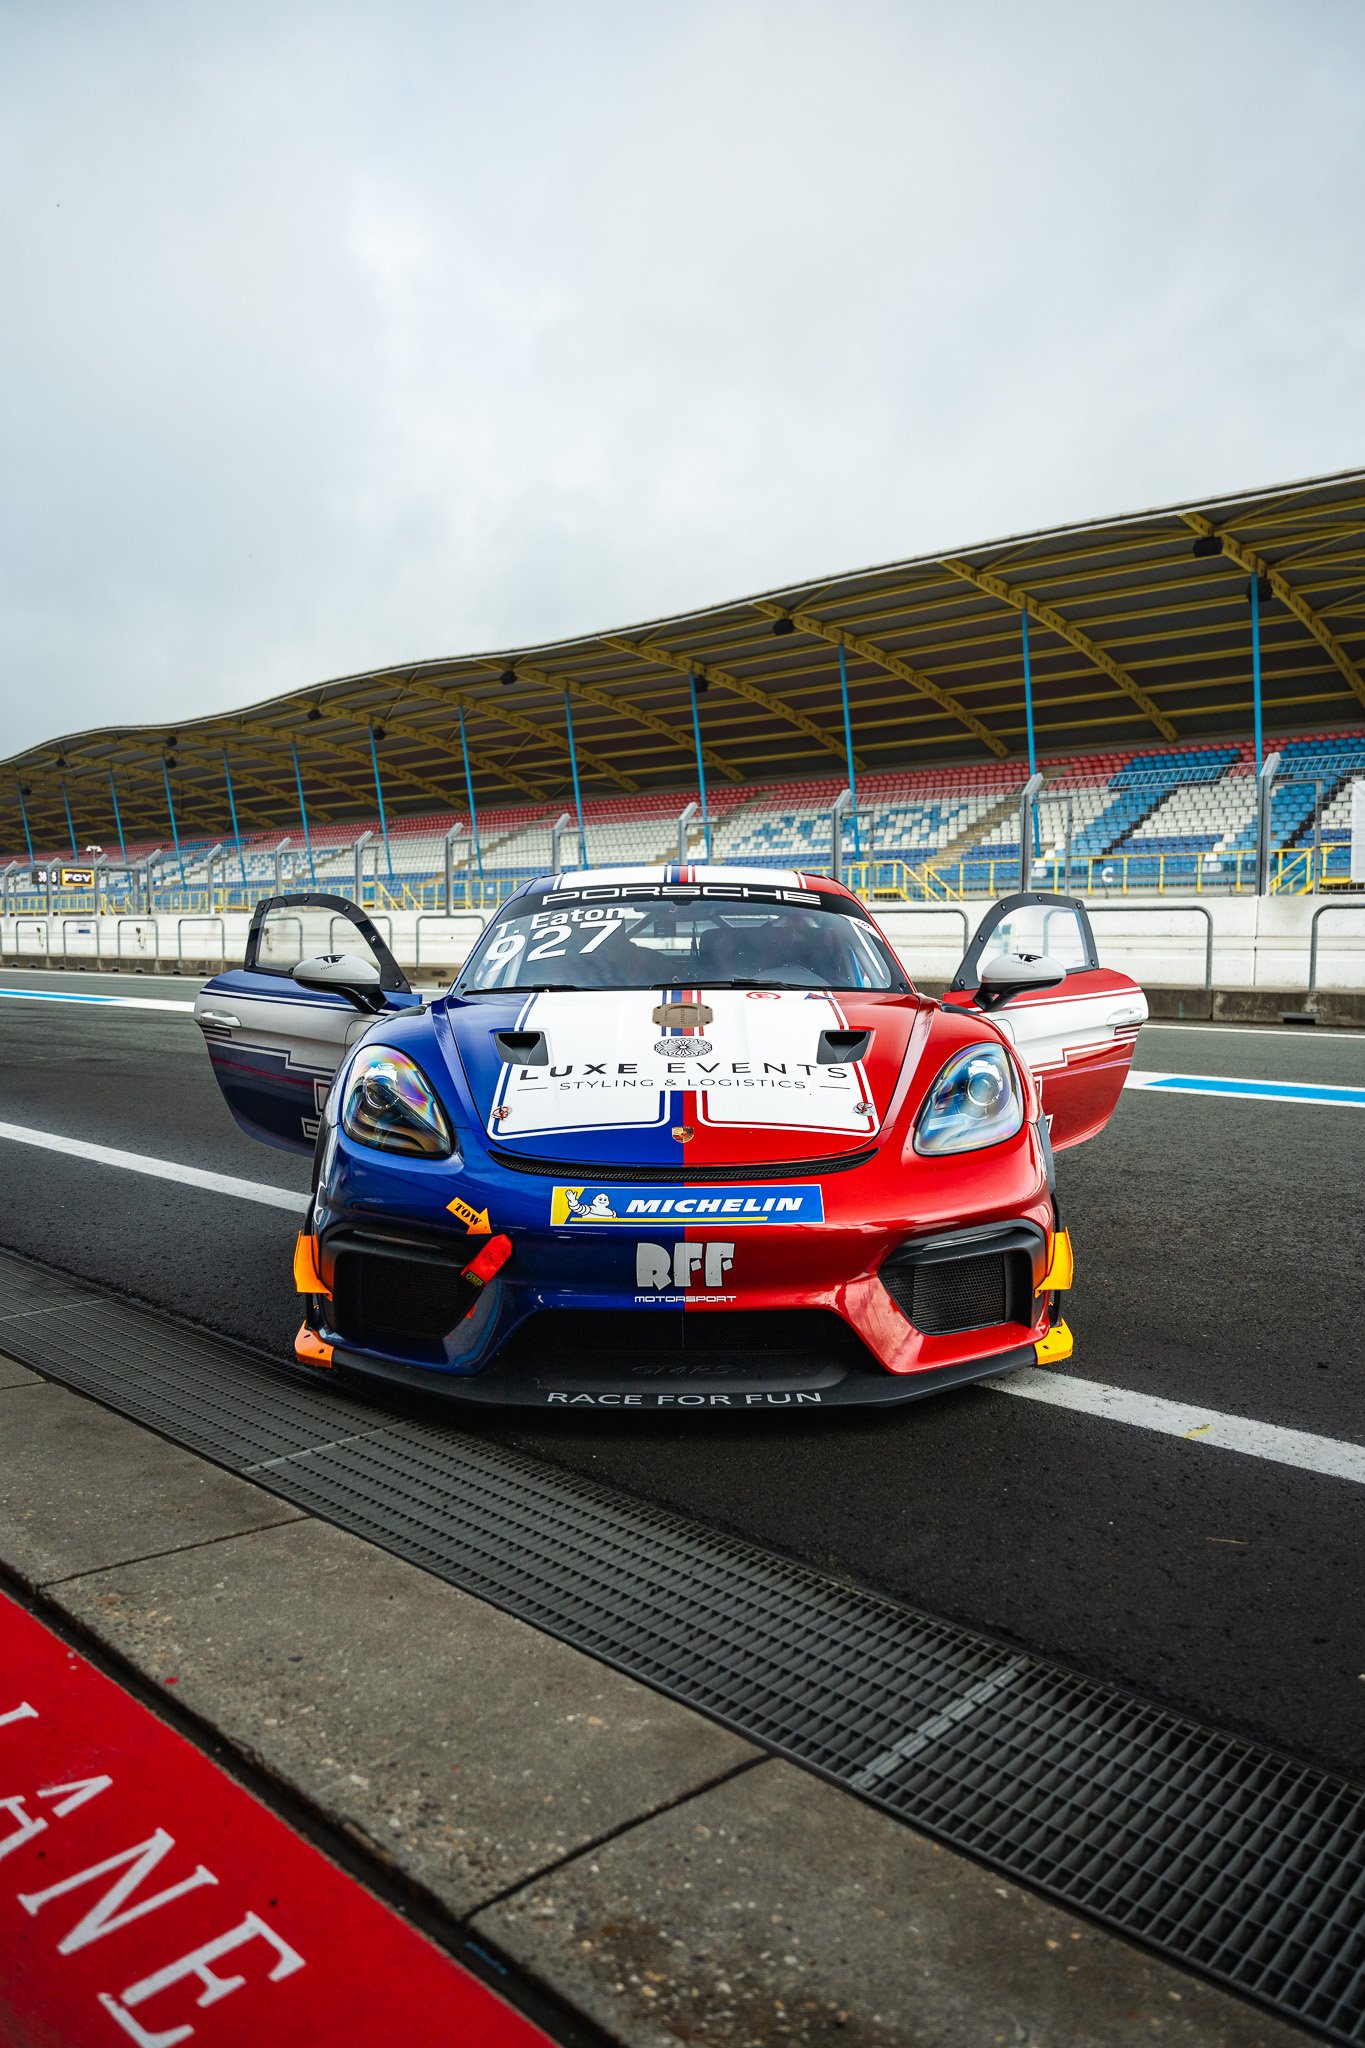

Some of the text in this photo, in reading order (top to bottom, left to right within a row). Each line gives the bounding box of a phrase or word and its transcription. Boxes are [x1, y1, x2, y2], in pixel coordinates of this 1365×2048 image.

[64, 873, 92, 882] FCY
[542, 885, 822, 906] PORSCHE
[496, 907, 625, 939] T. Eaton
[485, 919, 623, 973] 927
[520, 1062, 848, 1081] LUXE EVENTS
[560, 1079, 654, 1090] STYLING
[688, 1079, 806, 1089] LOGISTICS
[454, 1203, 482, 1226] TOW
[626, 1197, 803, 1213] MICHELIN
[636, 1242, 735, 1291] RFF
[547, 1392, 822, 1405] RACE FOR FUN
[0, 1701, 307, 2048] ANE
